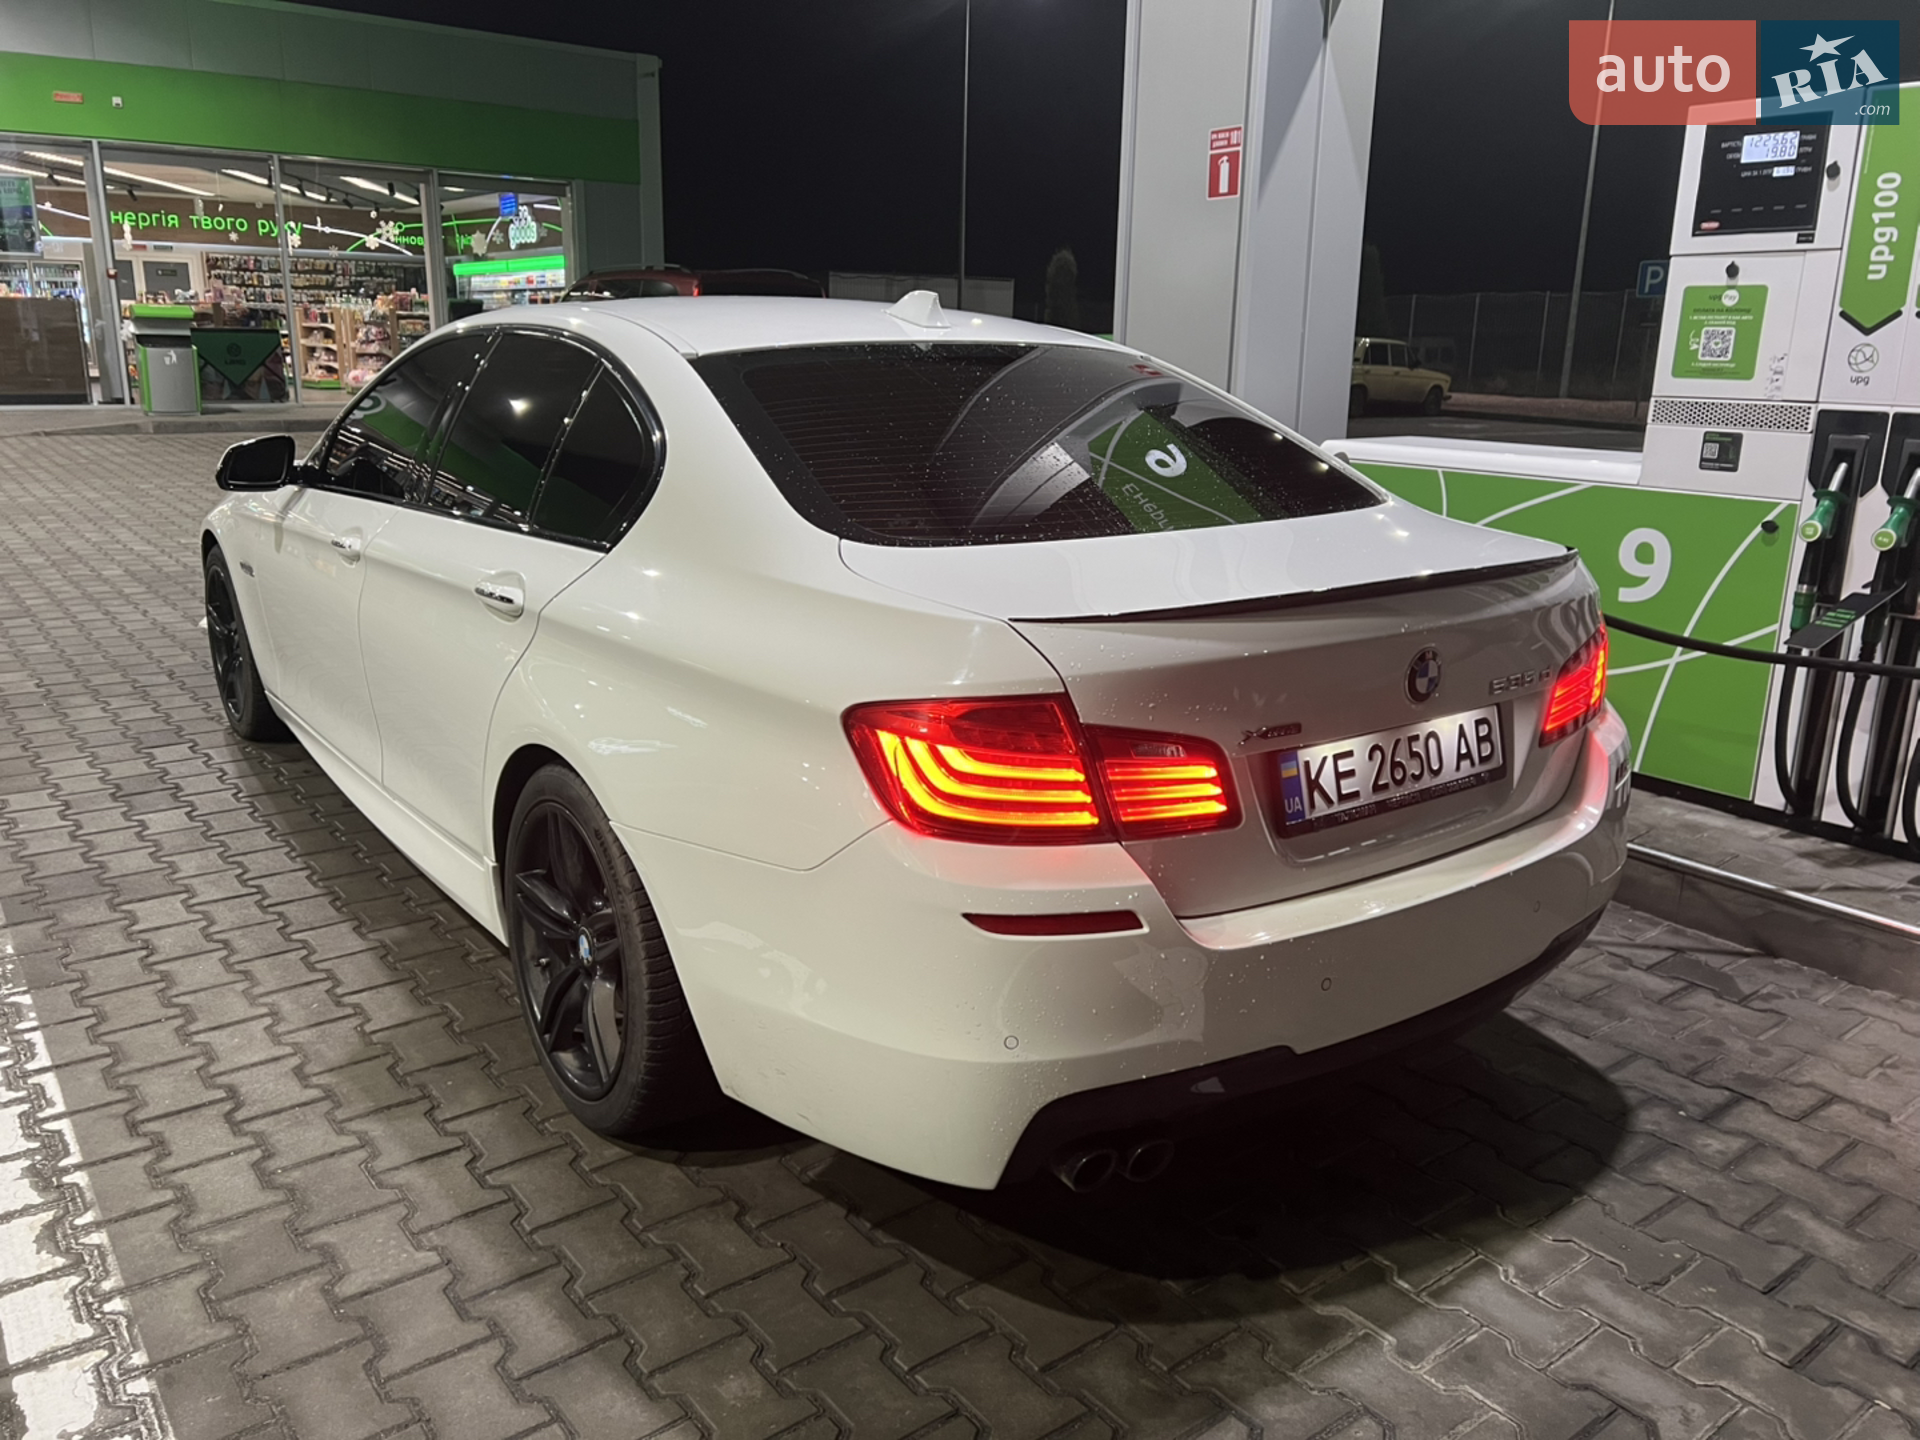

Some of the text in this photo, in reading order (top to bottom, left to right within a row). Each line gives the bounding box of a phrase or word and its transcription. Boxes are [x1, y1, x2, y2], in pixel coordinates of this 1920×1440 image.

[110, 210, 180, 230] нергія
[189, 214, 249, 232] твого
[1867, 171, 1902, 281] upg100
[1644, 265, 1665, 294] P
[1849, 374, 1870, 386] upg
[1617, 527, 1672, 603] 9
[1303, 716, 1495, 811] KE 2650 AB
[1285, 796, 1303, 814] UA
